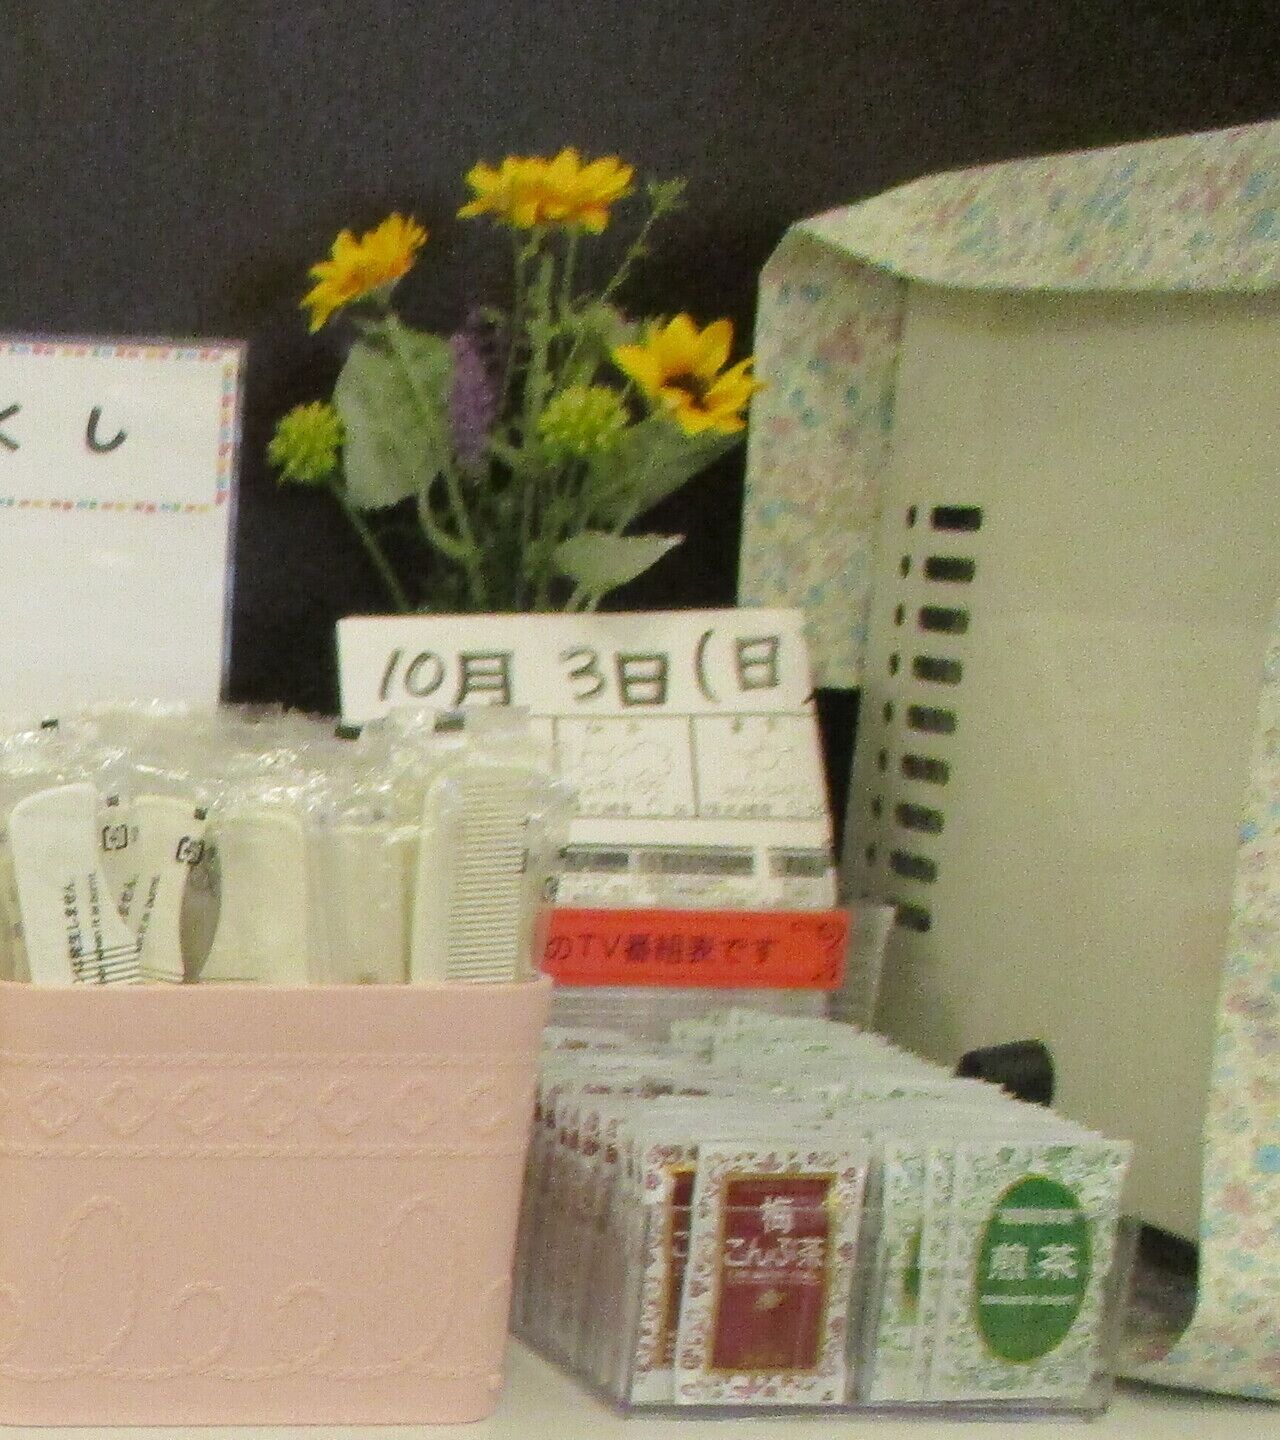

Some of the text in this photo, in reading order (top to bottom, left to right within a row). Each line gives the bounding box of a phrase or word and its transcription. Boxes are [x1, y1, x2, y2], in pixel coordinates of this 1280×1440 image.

[62, 880, 85, 986] は発生しません
